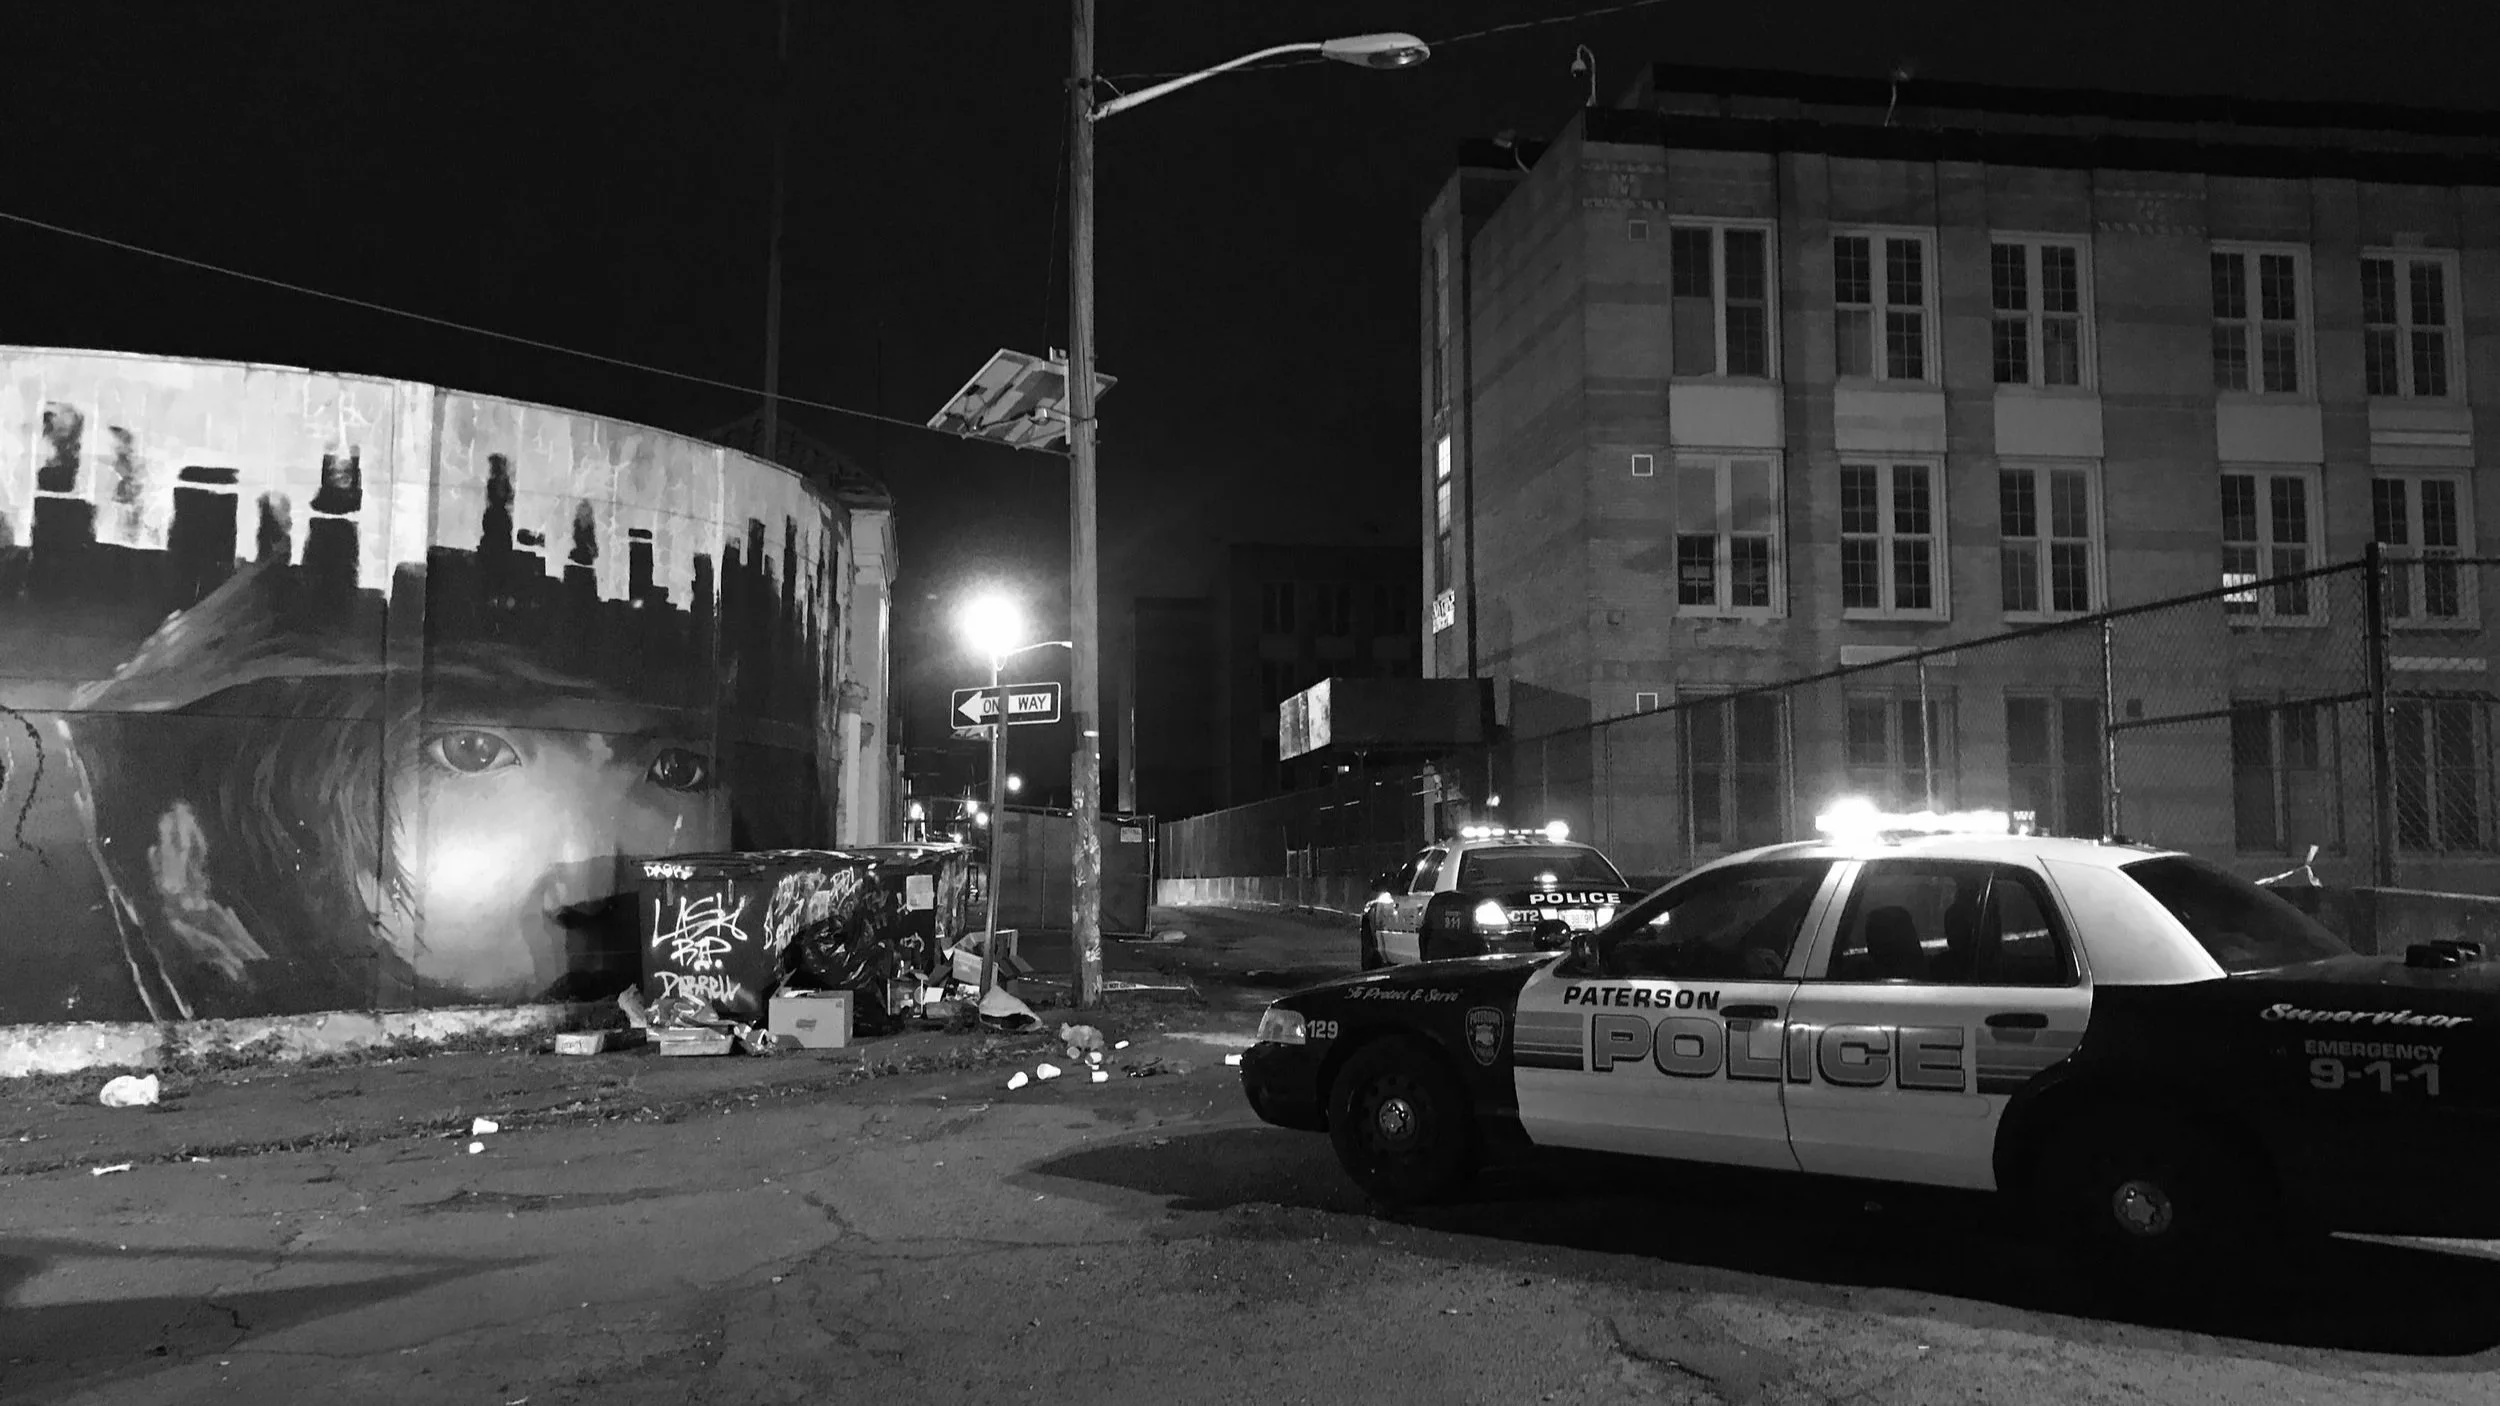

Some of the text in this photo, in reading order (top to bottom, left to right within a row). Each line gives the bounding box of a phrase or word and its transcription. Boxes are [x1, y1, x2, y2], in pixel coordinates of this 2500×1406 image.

[1018, 696, 1046, 711] WAY
[1530, 892, 1621, 904] POLICE
[1564, 985, 1720, 1011] PATERSON
[2260, 1003, 2473, 1028] Supervisor
[1307, 1020, 1338, 1039] 129
[1592, 1012, 1965, 1092] POLICE
[2304, 1039, 2443, 1061] EMERGENCY
[2309, 1057, 2440, 1096] 9-1-1
